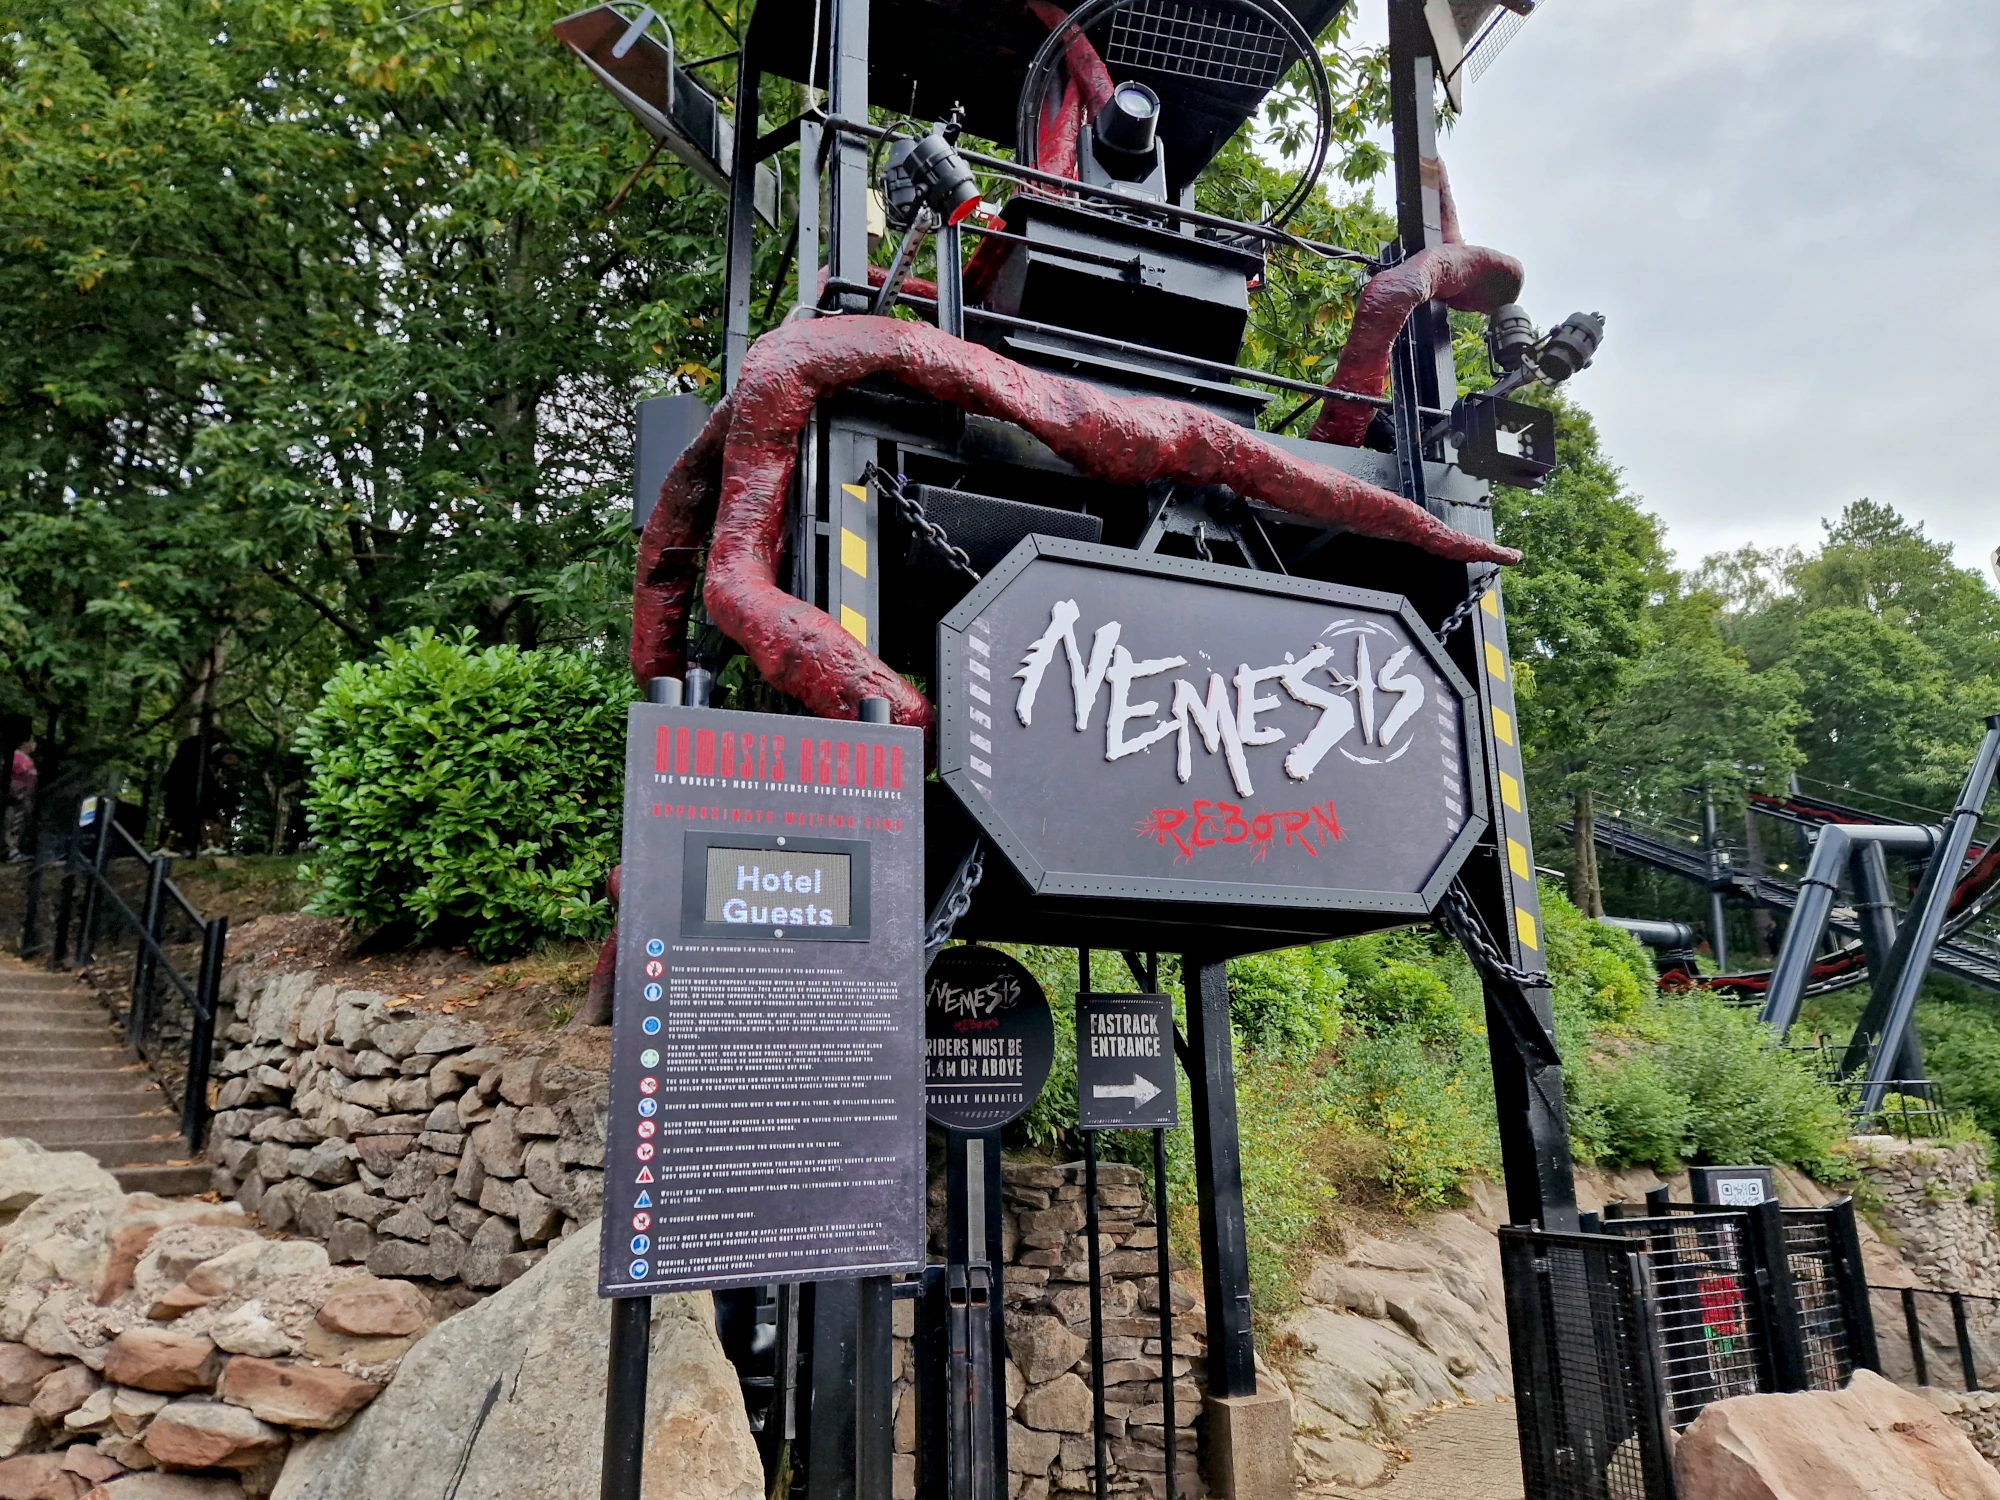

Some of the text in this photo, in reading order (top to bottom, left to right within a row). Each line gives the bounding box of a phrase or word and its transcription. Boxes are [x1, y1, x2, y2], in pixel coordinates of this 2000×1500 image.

[1012, 599, 1425, 798] NEMESIS
[655, 774, 902, 800] THE WORLD'S MOST INTENSE RIDE EXPERIENCE
[653, 803, 773, 824] APPROXIMATE
[784, 812, 855, 829] WAITING
[1133, 799, 1347, 865] REBORN
[736, 865, 822, 894] Hotel
[721, 898, 834, 926] Guests
[926, 978, 1021, 1019] NEMESIS
[1090, 1013, 1159, 1034] FASTRACK
[926, 1038, 1022, 1056] RIDERS MUST BE
[1091, 1036, 1161, 1057] ENTRANCE
[925, 1058, 1023, 1077] 1.4M OR ABOVE
[925, 1093, 1023, 1104] PHALANX MANDATED
